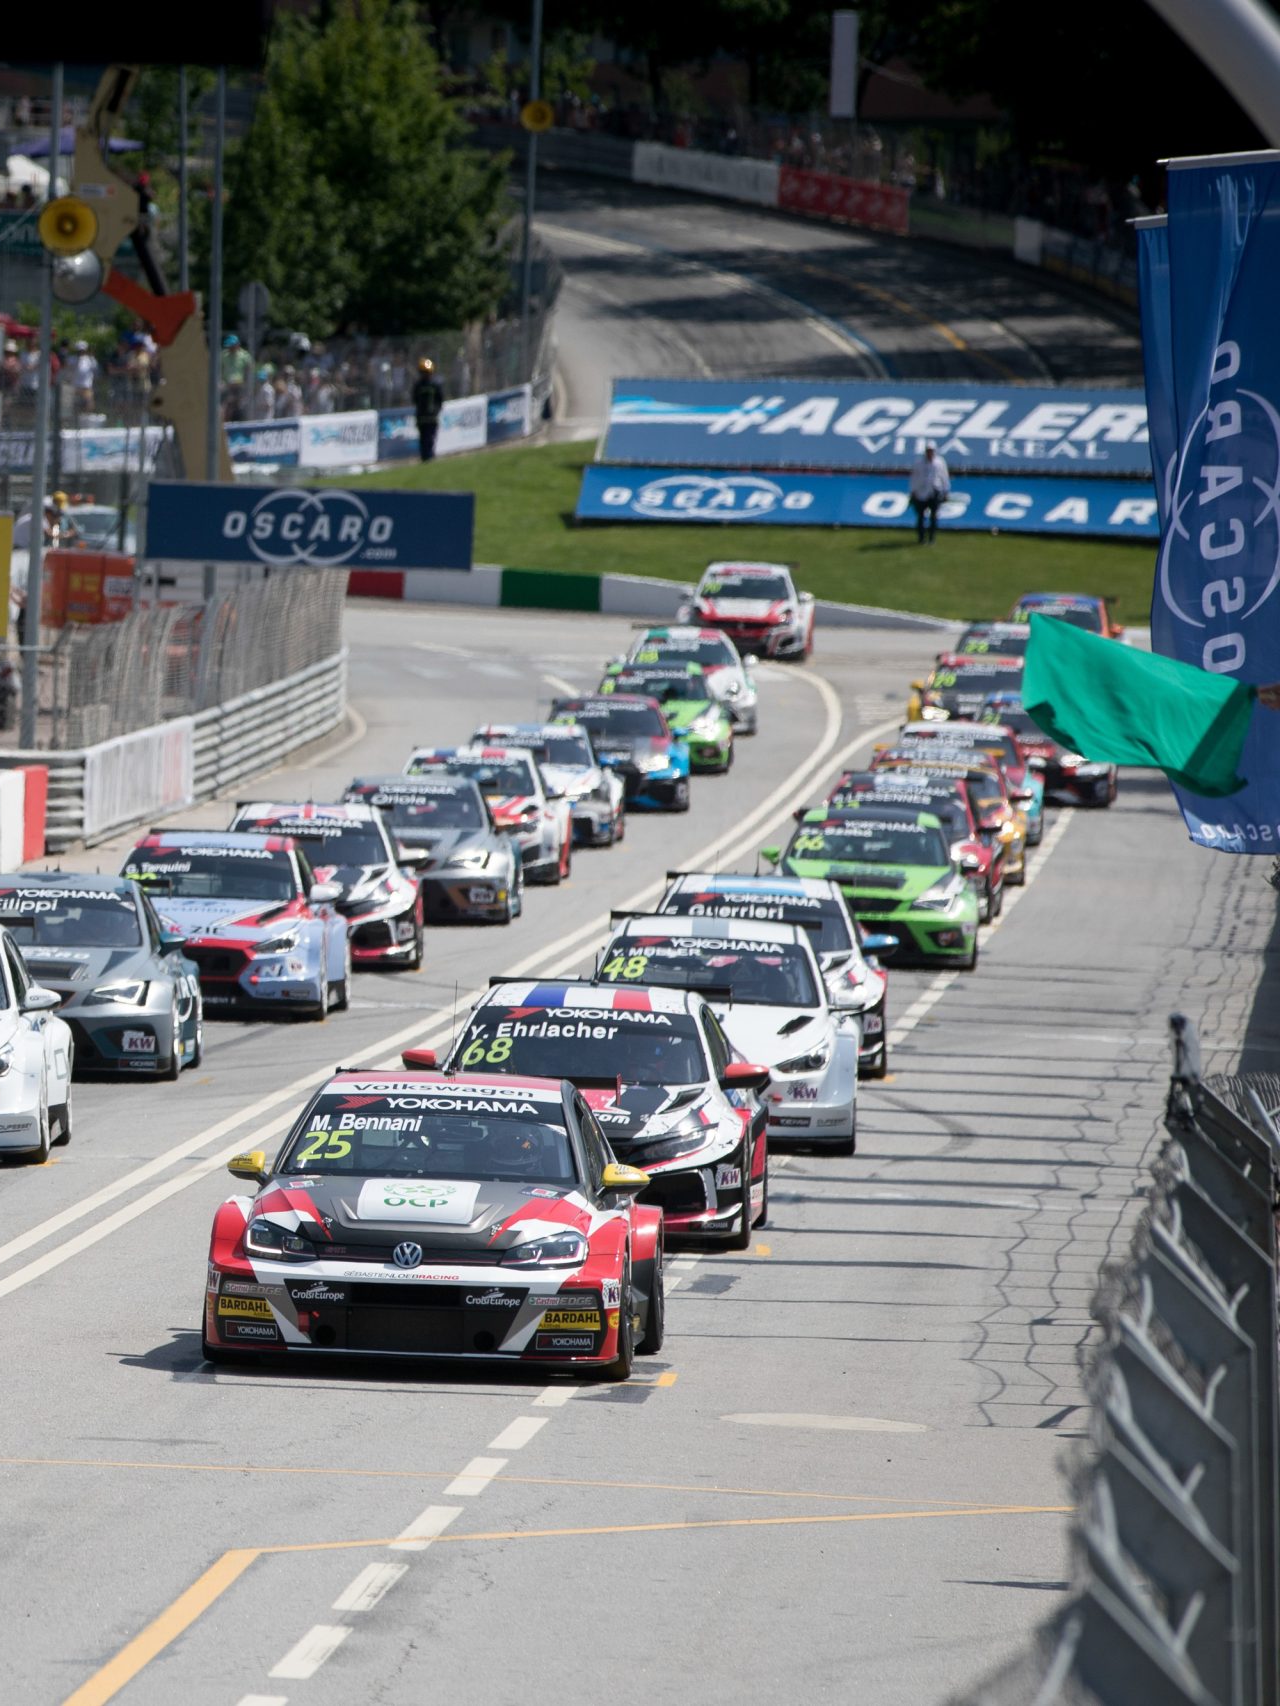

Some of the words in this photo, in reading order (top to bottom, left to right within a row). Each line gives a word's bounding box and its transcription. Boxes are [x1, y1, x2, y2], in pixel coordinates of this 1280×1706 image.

[759, 396, 1149, 442] ACELER
[857, 435, 969, 455] VIA
[989, 439, 1109, 459] REAL
[601, 487, 814, 510] OSCARO
[862, 491, 1157, 525] OSCAR
[223, 510, 394, 543] OSCARO
[180, 847, 273, 859] YOKOHAMA
[142, 861, 192, 874] Tarquini
[16, 889, 122, 901] YOKOHAMA
[722, 893, 822, 909] YOKOHAMA
[688, 903, 784, 920] Guerrieri
[669, 937, 785, 955] YOKOHAMA
[603, 955, 648, 982] 48
[545, 1007, 672, 1026] YOKOHAMA
[469, 1023, 489, 1041] Y.
[496, 1020, 618, 1040] Ehrlacher
[128, 1037, 155, 1050] KW
[461, 1037, 514, 1066] 68
[353, 1084, 535, 1098] Volkswagen
[792, 1088, 819, 1099] KW
[386, 1098, 539, 1115] YOKOHAMA
[310, 1115, 333, 1132] M.
[338, 1114, 424, 1132] Bennani
[297, 1130, 356, 1161] 25
[721, 1171, 739, 1185] KW
[384, 1197, 449, 1208] OCP
[250, 1286, 283, 1296] EDGE
[220, 1299, 271, 1313] BARDAHL
[465, 1294, 521, 1306] CroisiEurope
[560, 1296, 594, 1305] EDGE
[544, 1313, 600, 1324] BARDAHL
[237, 1326, 275, 1336] YOKOHAMA
[552, 1338, 591, 1346] YOKOHAMA
